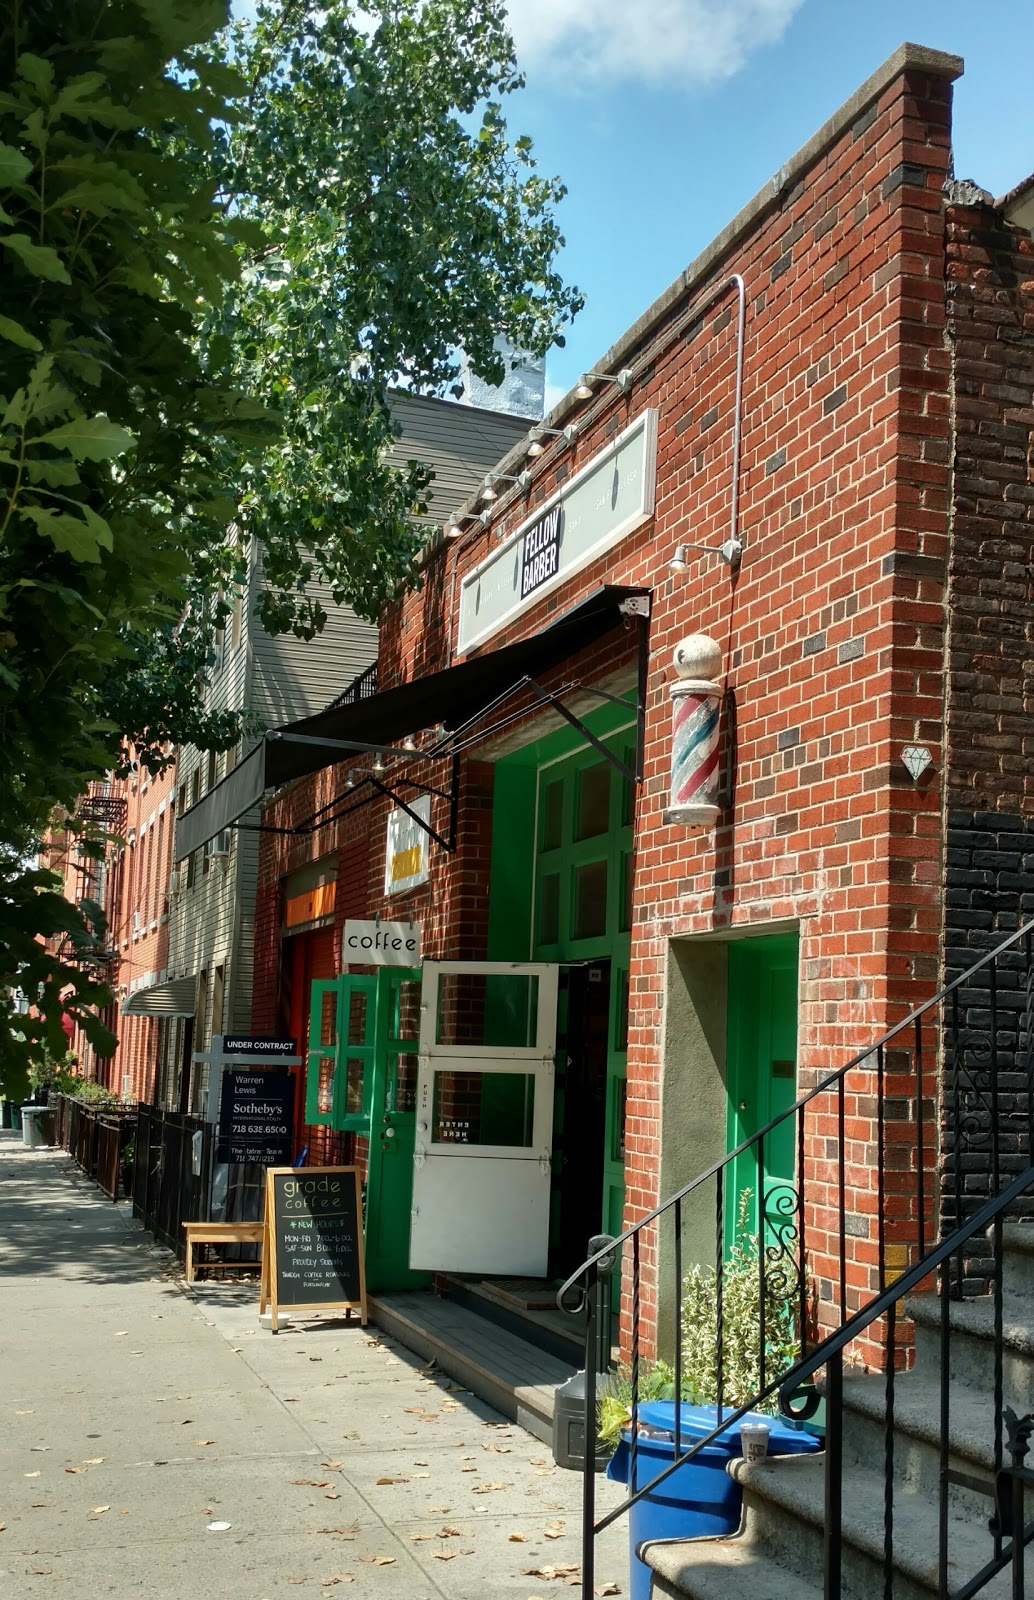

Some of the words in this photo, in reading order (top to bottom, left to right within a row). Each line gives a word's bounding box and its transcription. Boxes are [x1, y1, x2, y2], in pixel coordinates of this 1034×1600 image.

[524, 508, 559, 562] FELLOW
[522, 542, 557, 595] BARBER
[348, 931, 417, 951] coffee
[227, 1041, 253, 1049] UNDER
[254, 1041, 294, 1050] CONTRACT
[235, 1075, 264, 1084] Warren
[234, 1086, 257, 1094] Lewis
[233, 1103, 283, 1116] Sotheby's
[283, 1176, 341, 1198] grade
[285, 1195, 341, 1209] coffee
[285, 1244, 312, 1252] SAT-SUN
